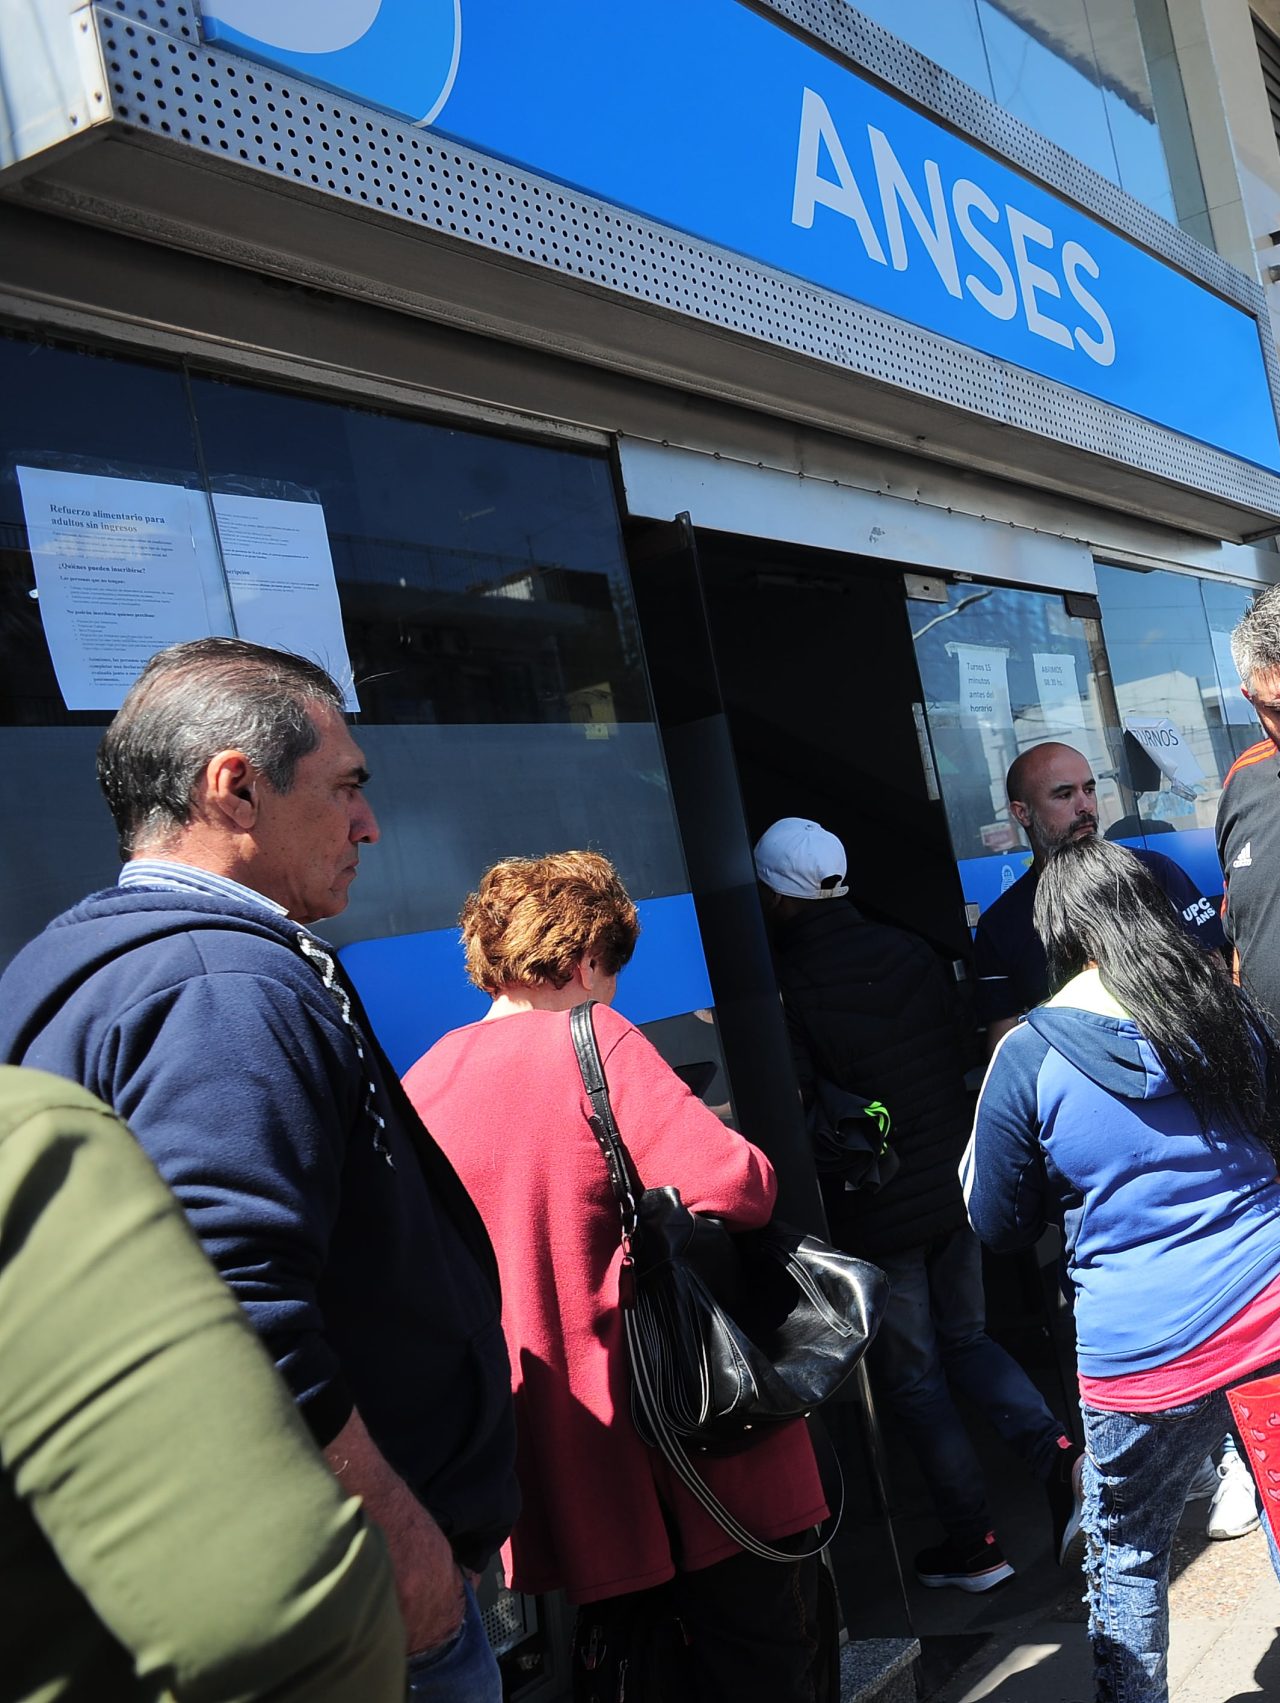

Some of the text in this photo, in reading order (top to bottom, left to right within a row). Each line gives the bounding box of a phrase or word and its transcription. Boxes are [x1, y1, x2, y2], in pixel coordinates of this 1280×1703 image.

[791, 86, 1116, 367] ANSES
[50, 504, 166, 524] Refuerzo alimentario para
[51, 517, 138, 533] adultos sin ingresos
[970, 704, 993, 713] horario
[1131, 728, 1179, 747] TURNOS
[1182, 897, 1211, 921] UPC
[1195, 907, 1216, 926] ANS
